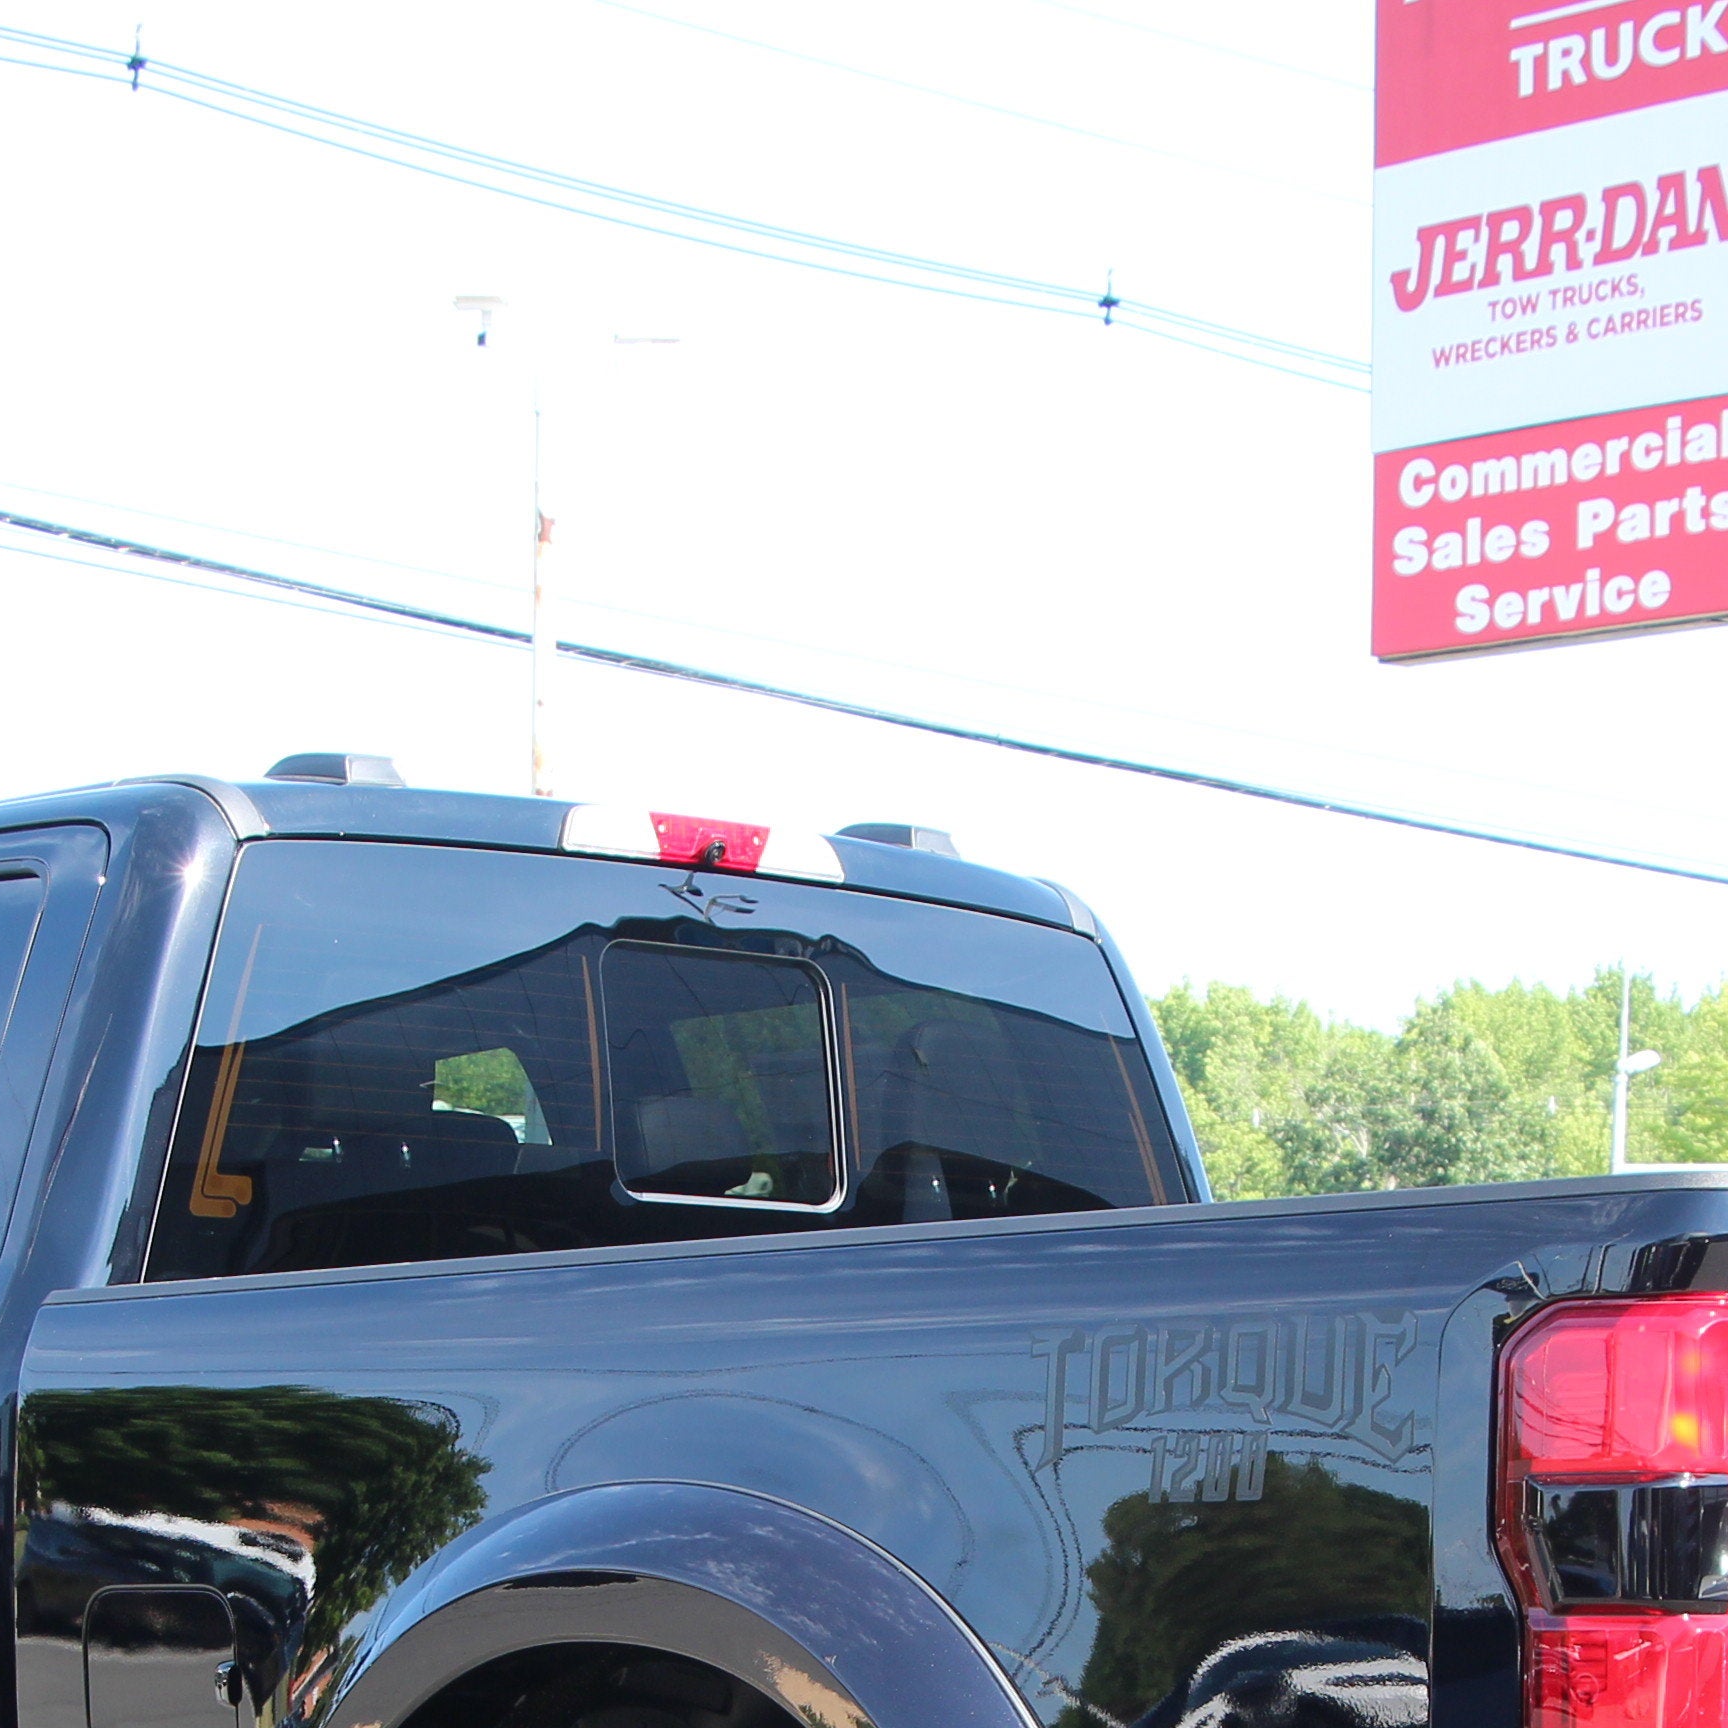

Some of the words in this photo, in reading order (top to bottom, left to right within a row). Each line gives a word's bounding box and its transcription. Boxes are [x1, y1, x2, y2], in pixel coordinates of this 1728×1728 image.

[1487, 293, 1540, 323] TOW
[1548, 274, 1646, 308] TRUCKS,
[1431, 324, 1558, 370] WRECKERS
[1564, 321, 1580, 345] &
[1585, 298, 1704, 340] CARRIERS
[1391, 516, 1551, 578] Sales
[1454, 567, 1673, 636] Service
[1148, 1429, 1270, 1504] 1200
